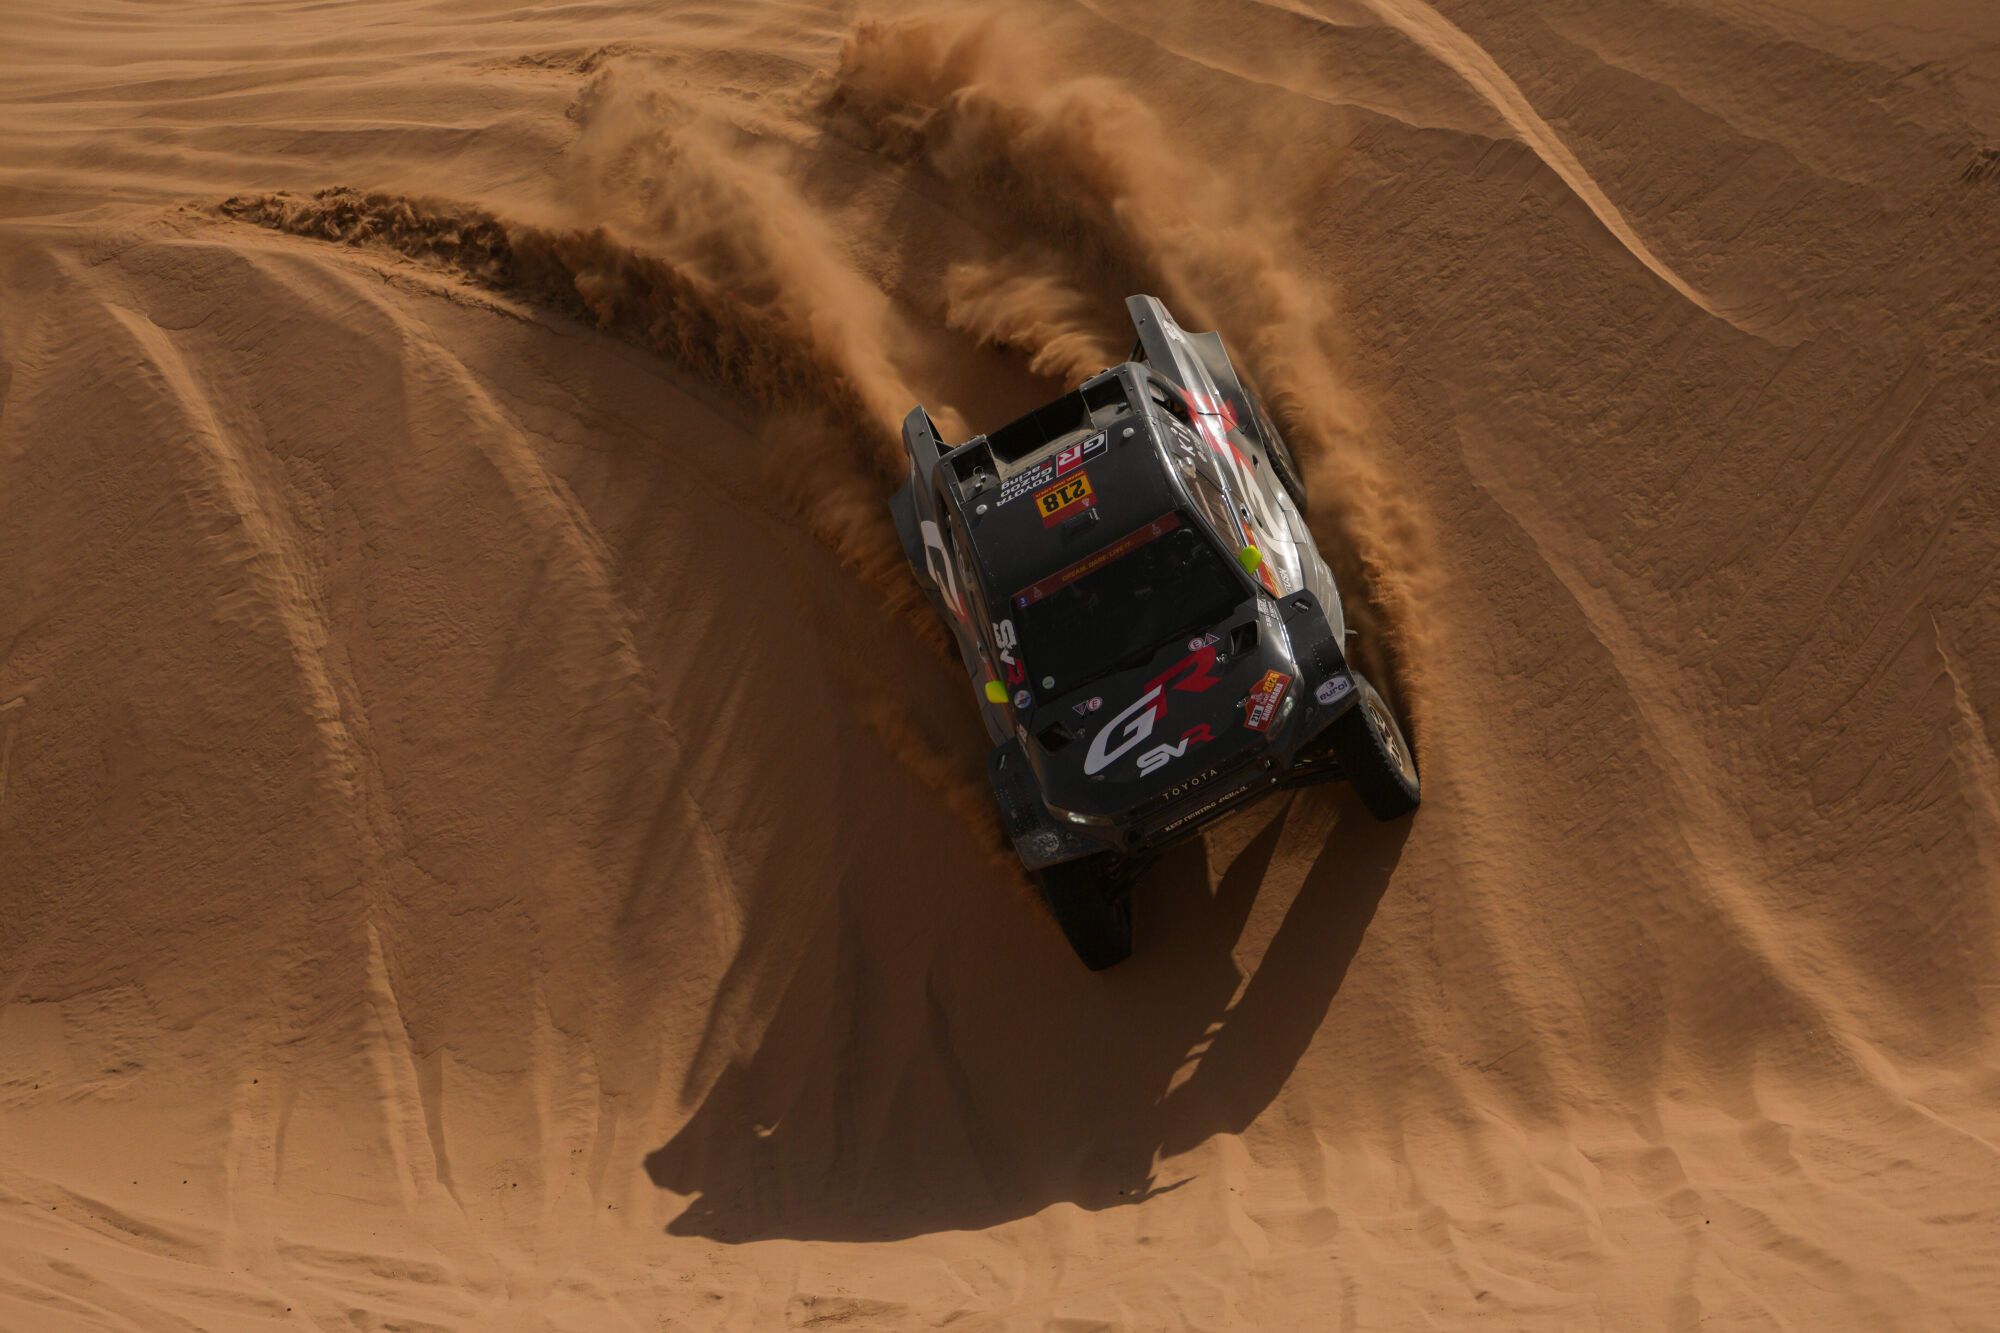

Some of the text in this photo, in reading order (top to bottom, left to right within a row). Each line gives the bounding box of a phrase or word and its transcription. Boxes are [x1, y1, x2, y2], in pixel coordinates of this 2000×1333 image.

[1058, 433, 1105, 466] GR
[996, 475, 1054, 507] TOYOTA
[1000, 466, 1053, 498] GAZOO
[1043, 479, 1086, 513] 218
[1263, 672, 1280, 693] 2026
[1319, 681, 1348, 701] eurol
[1083, 645, 1223, 776] GR
[1251, 709, 1261, 722] 218
[1261, 703, 1274, 722] SAUDI
[1269, 682, 1284, 704] ARABIA
[1136, 722, 1217, 779] SVR
[1163, 769, 1217, 800] TOYOTA
